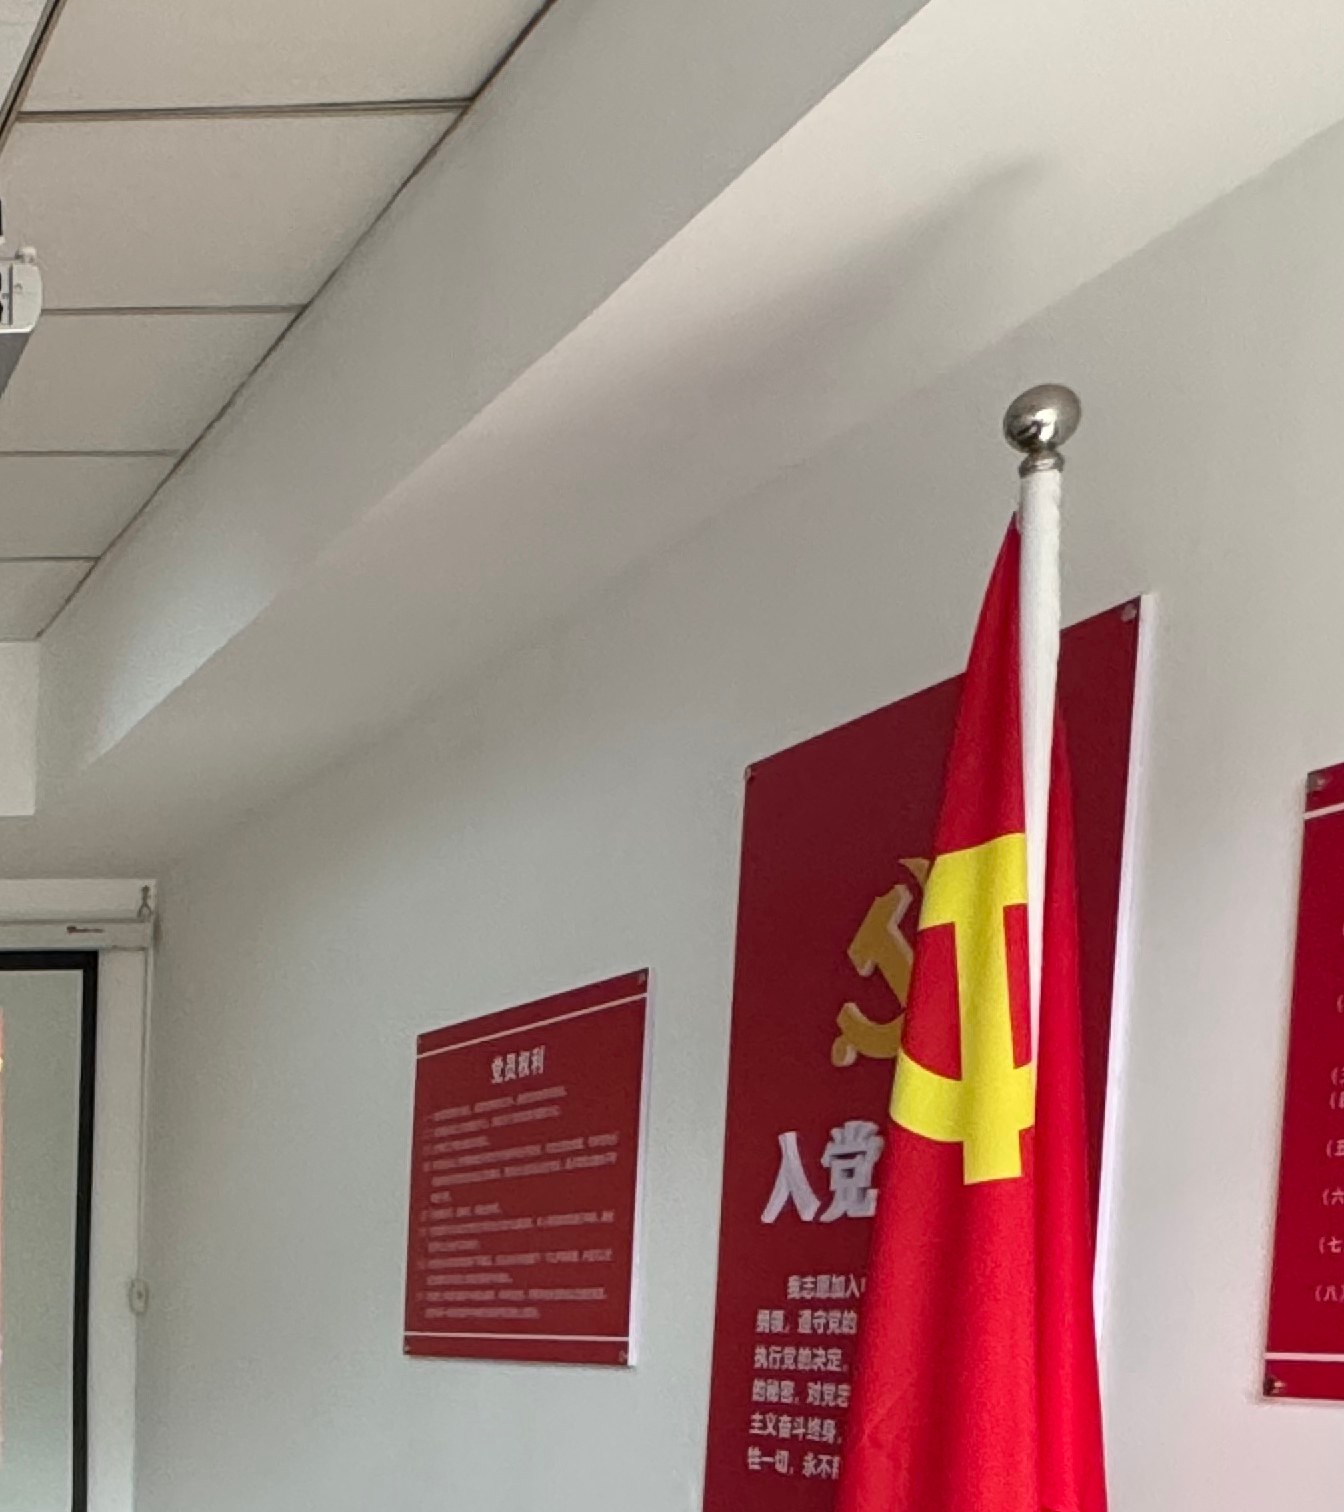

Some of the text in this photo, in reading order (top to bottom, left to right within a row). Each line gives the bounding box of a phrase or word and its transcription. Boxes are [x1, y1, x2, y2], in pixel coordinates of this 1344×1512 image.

[491, 1045, 545, 1084] 党员权利
[760, 1120, 886, 1223] 入党
[787, 1273, 866, 1300] 我志愿加入
